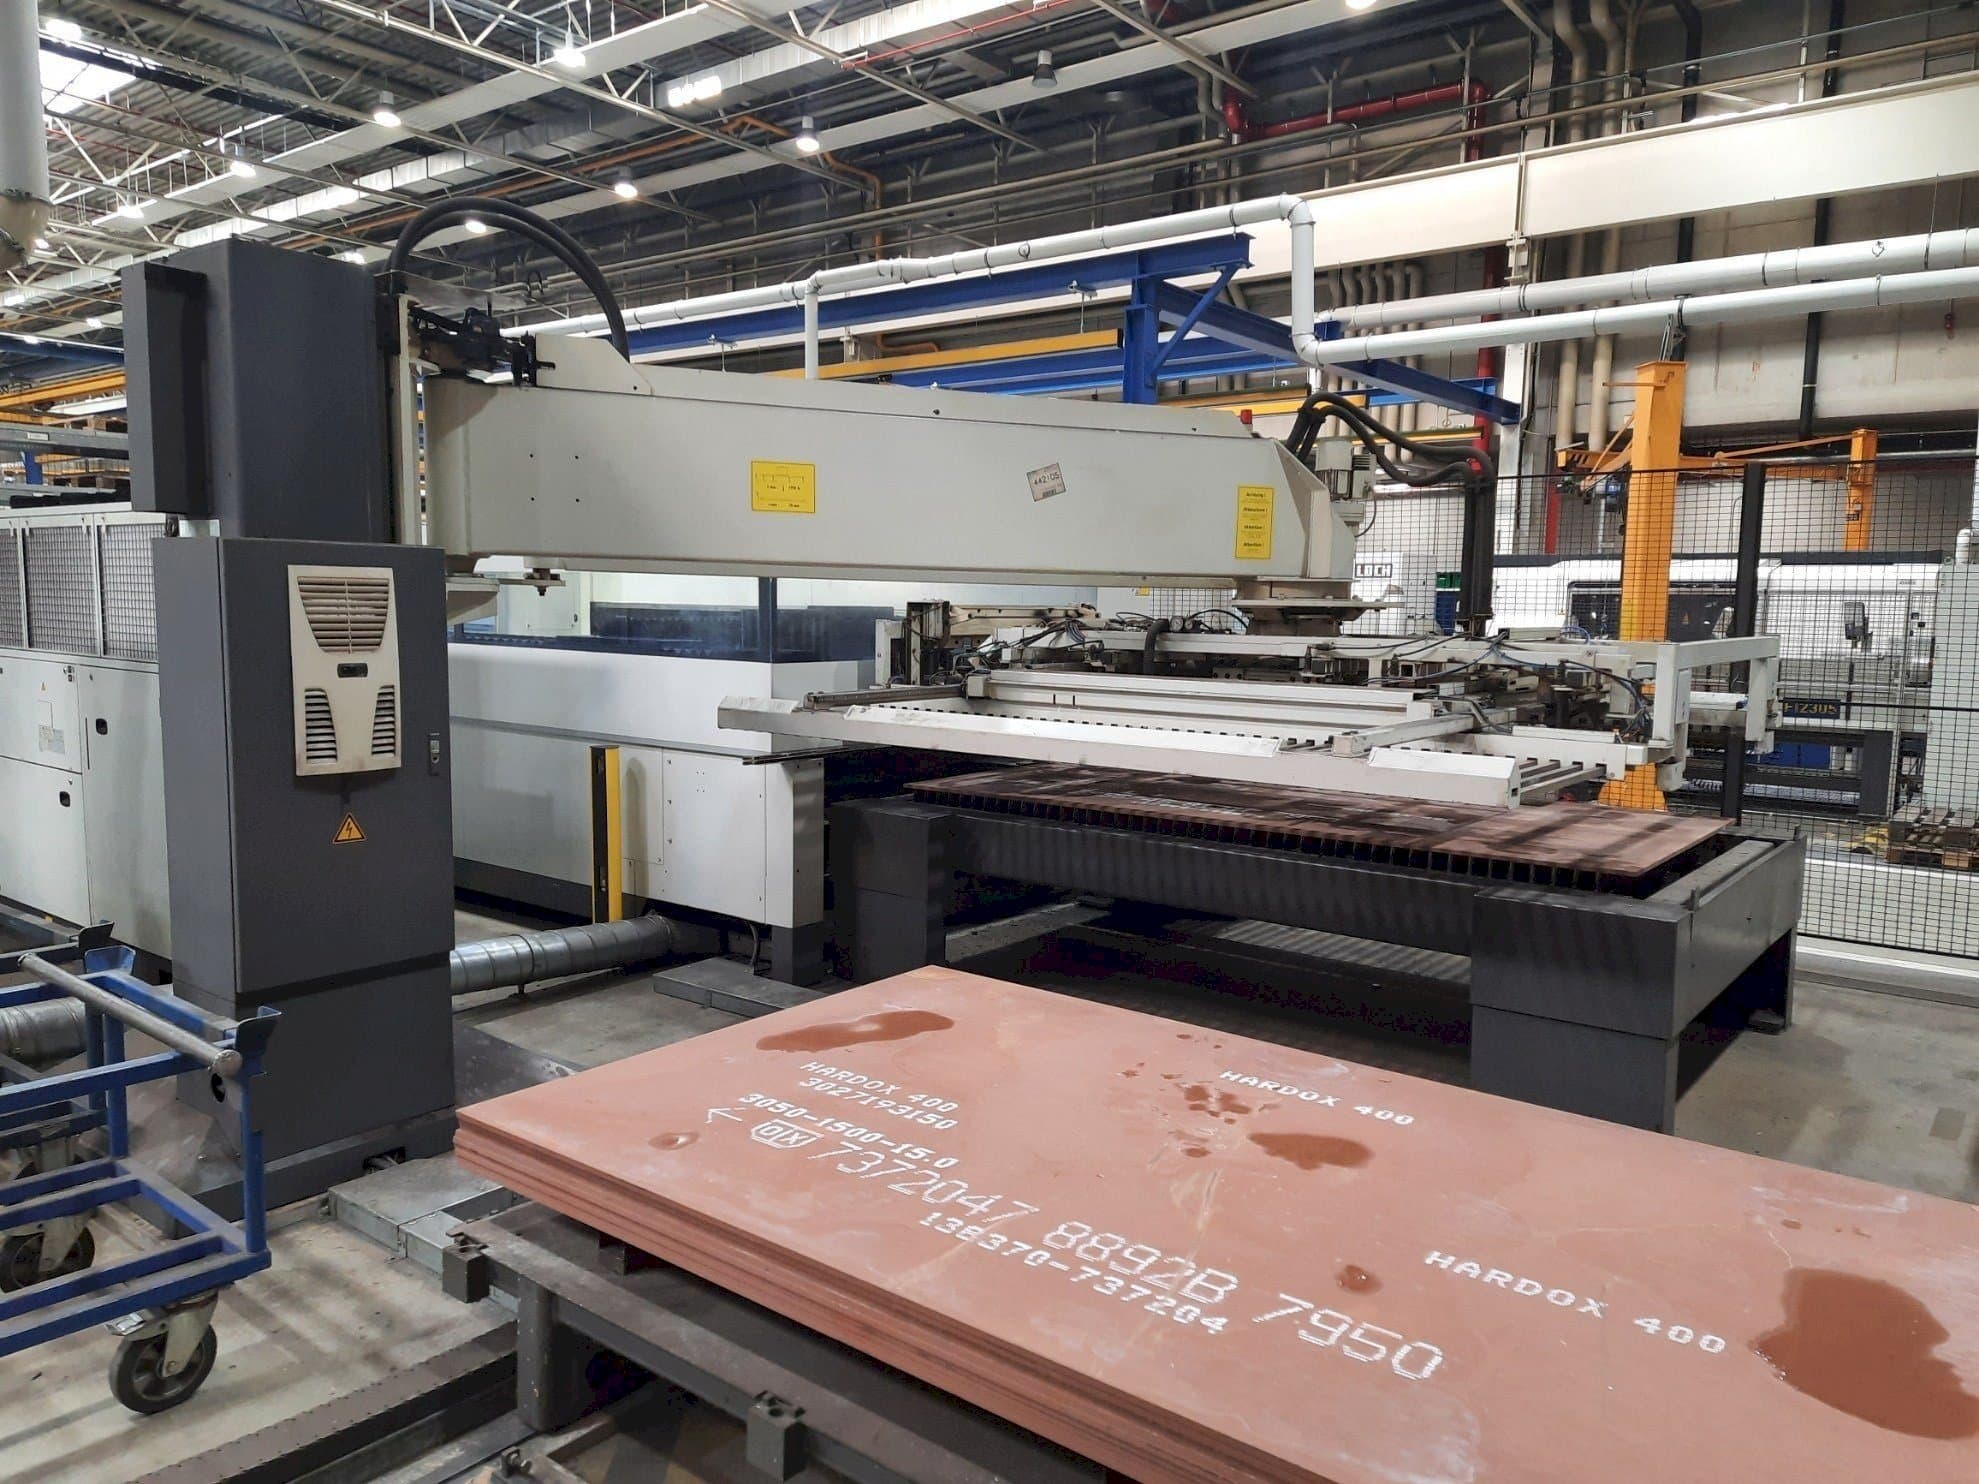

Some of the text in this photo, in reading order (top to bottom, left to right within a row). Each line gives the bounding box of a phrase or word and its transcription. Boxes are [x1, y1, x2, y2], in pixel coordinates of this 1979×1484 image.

[798, 1077, 959, 1130] 3027193150
[800, 1062, 959, 1113] HARDOX 400
[1219, 1070, 1415, 1126] HARDOX 400
[737, 1093, 960, 1168] 3050-1500-15.0
[807, 1141, 1041, 1222] 7372047
[1042, 1221, 1239, 1305] 8892B
[1252, 1292, 1444, 1381] 7950
[1424, 1250, 1727, 1355] HARDOX 400
